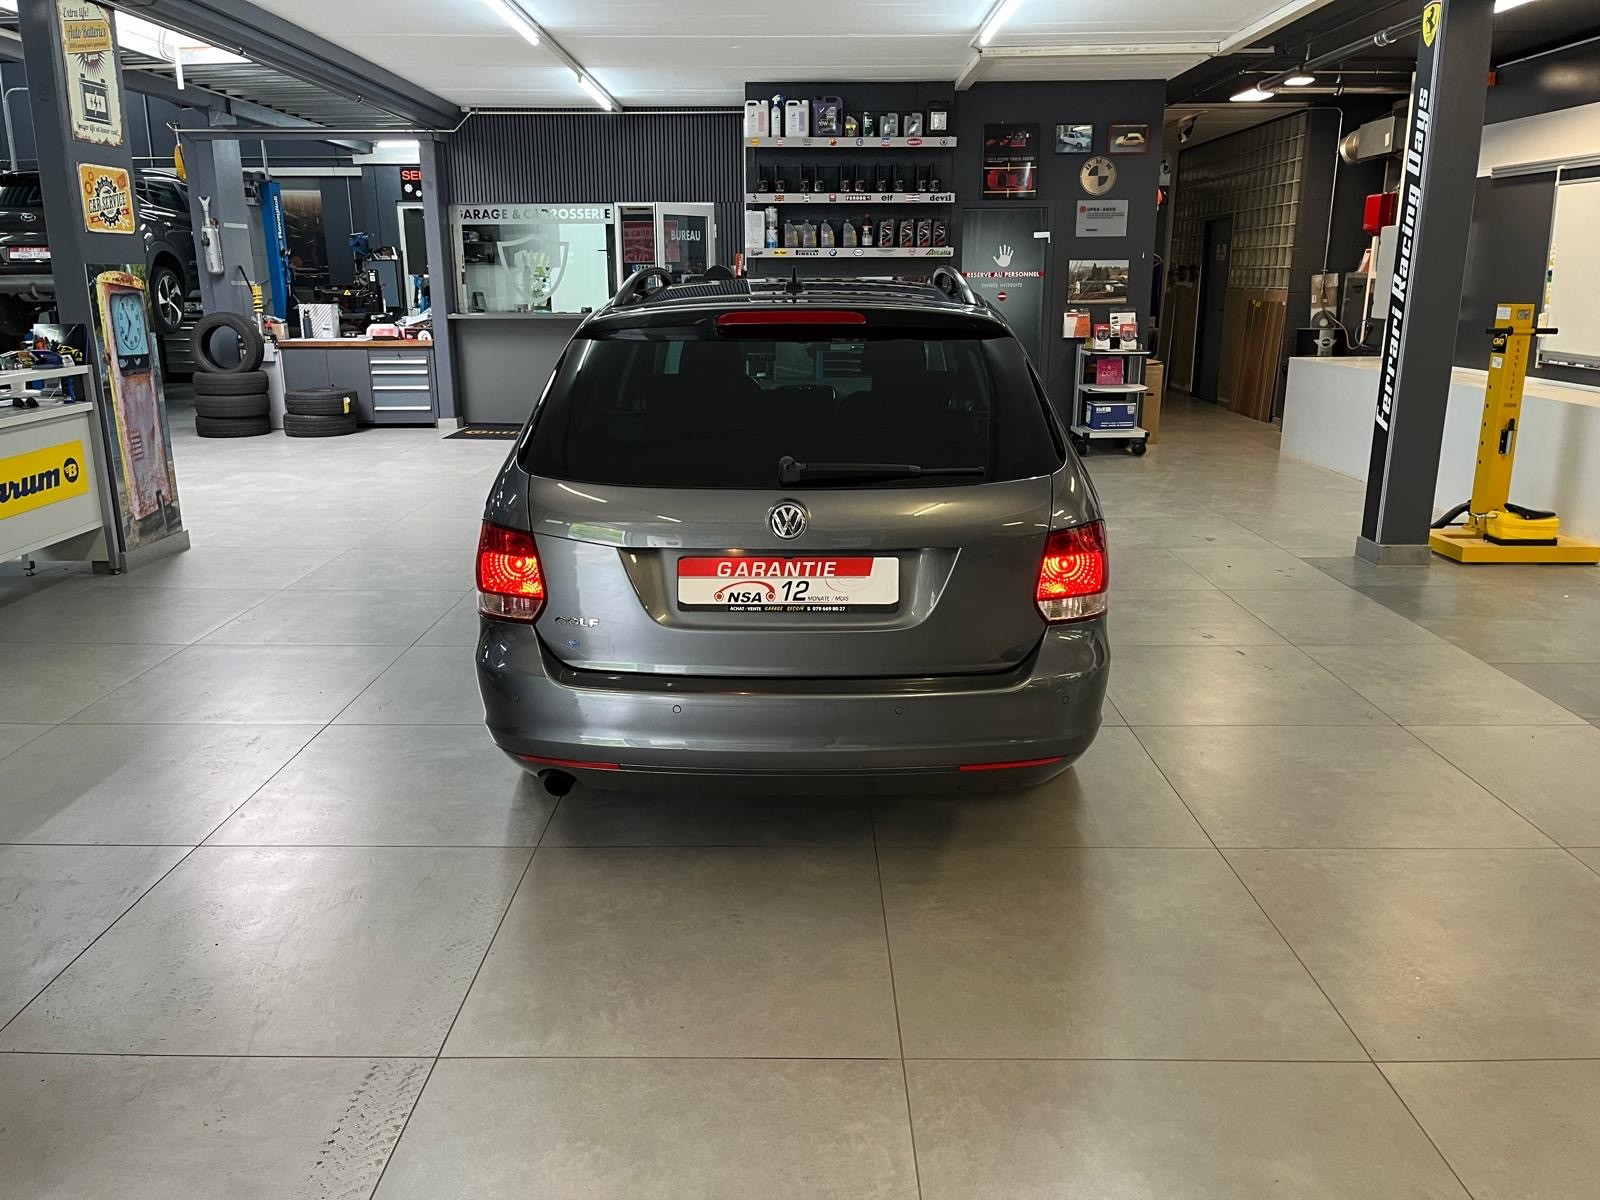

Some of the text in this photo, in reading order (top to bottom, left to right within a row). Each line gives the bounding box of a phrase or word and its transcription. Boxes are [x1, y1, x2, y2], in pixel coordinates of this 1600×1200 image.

[401, 170, 421, 181] SE
[88, 192, 126, 213] CAR SERVICE
[929, 194, 952, 202] devil
[459, 208, 508, 220] ARAGE
[512, 208, 521, 220] &
[671, 230, 701, 241] BUREAU
[1375, 87, 1430, 432] Ferrari Racing Days
[717, 561, 837, 577] GARANTIE
[727, 592, 762, 603] NSA
[781, 580, 810, 601] 12
[554, 616, 600, 628] GOLF
